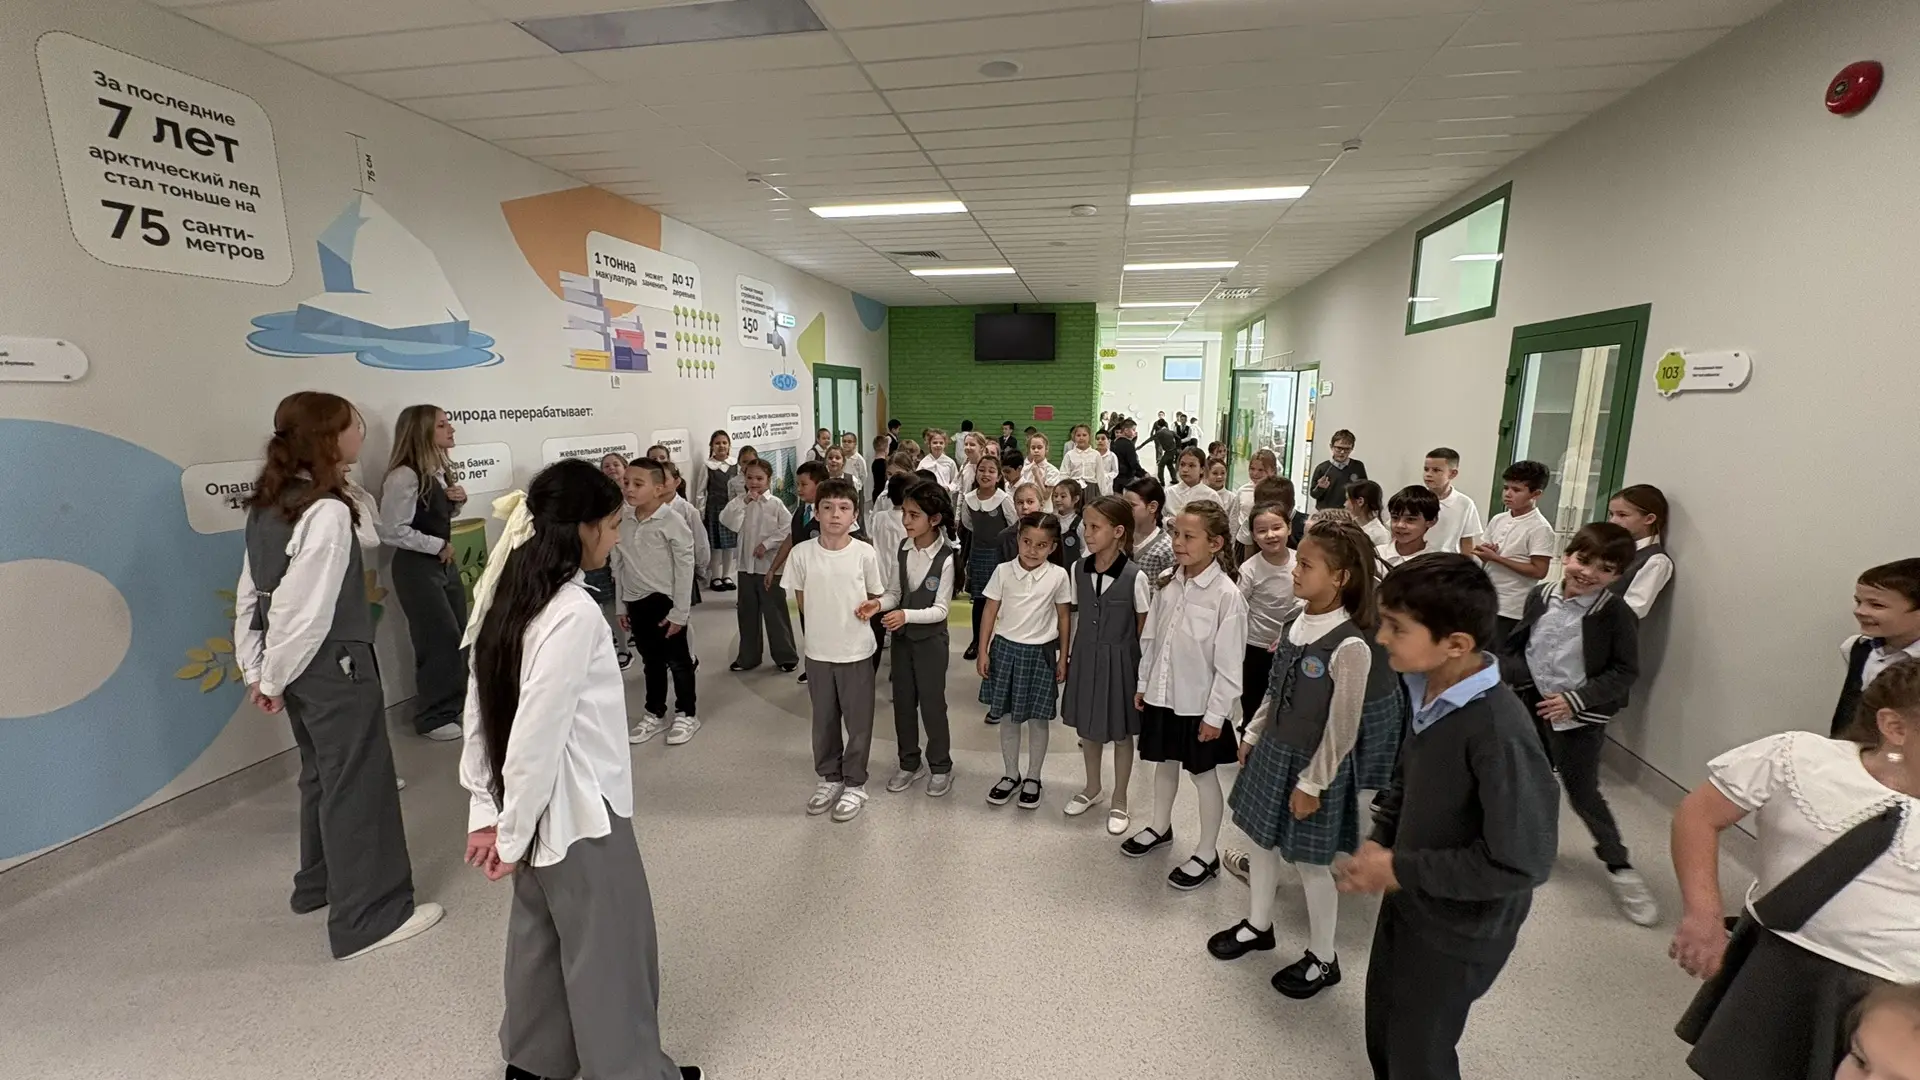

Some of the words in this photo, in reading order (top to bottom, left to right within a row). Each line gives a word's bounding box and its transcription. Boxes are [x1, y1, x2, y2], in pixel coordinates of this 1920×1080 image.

[93, 69, 122, 92] За
[127, 84, 236, 126] последние
[98, 97, 132, 139] 7
[152, 117, 239, 163] лет
[88, 146, 223, 187] арктический
[228, 178, 261, 198] лед
[367, 169, 376, 182] 75
[104, 171, 154, 191] стал
[159, 182, 231, 208] тоньше
[235, 199, 256, 213] на
[101, 199, 170, 246] 75
[182, 218, 254, 241] санти-
[186, 236, 265, 260] метров
[594, 252, 602, 264] 1
[603, 254, 636, 273] тонна
[595, 269, 637, 287] макулатуры
[672, 273, 683, 286] до
[684, 276, 694, 289] 17
[742, 316, 758, 333] 150
[1662, 366, 1680, 379] 103
[445, 410, 496, 424] рирода
[500, 406, 594, 422] перерабатывает:
[732, 431, 751, 440] около
[753, 422, 769, 438] 10%
[559, 447, 602, 458] жевательная
[602, 445, 627, 454] резинка
[467, 458, 495, 468] банка
[469, 469, 488, 480] лет
